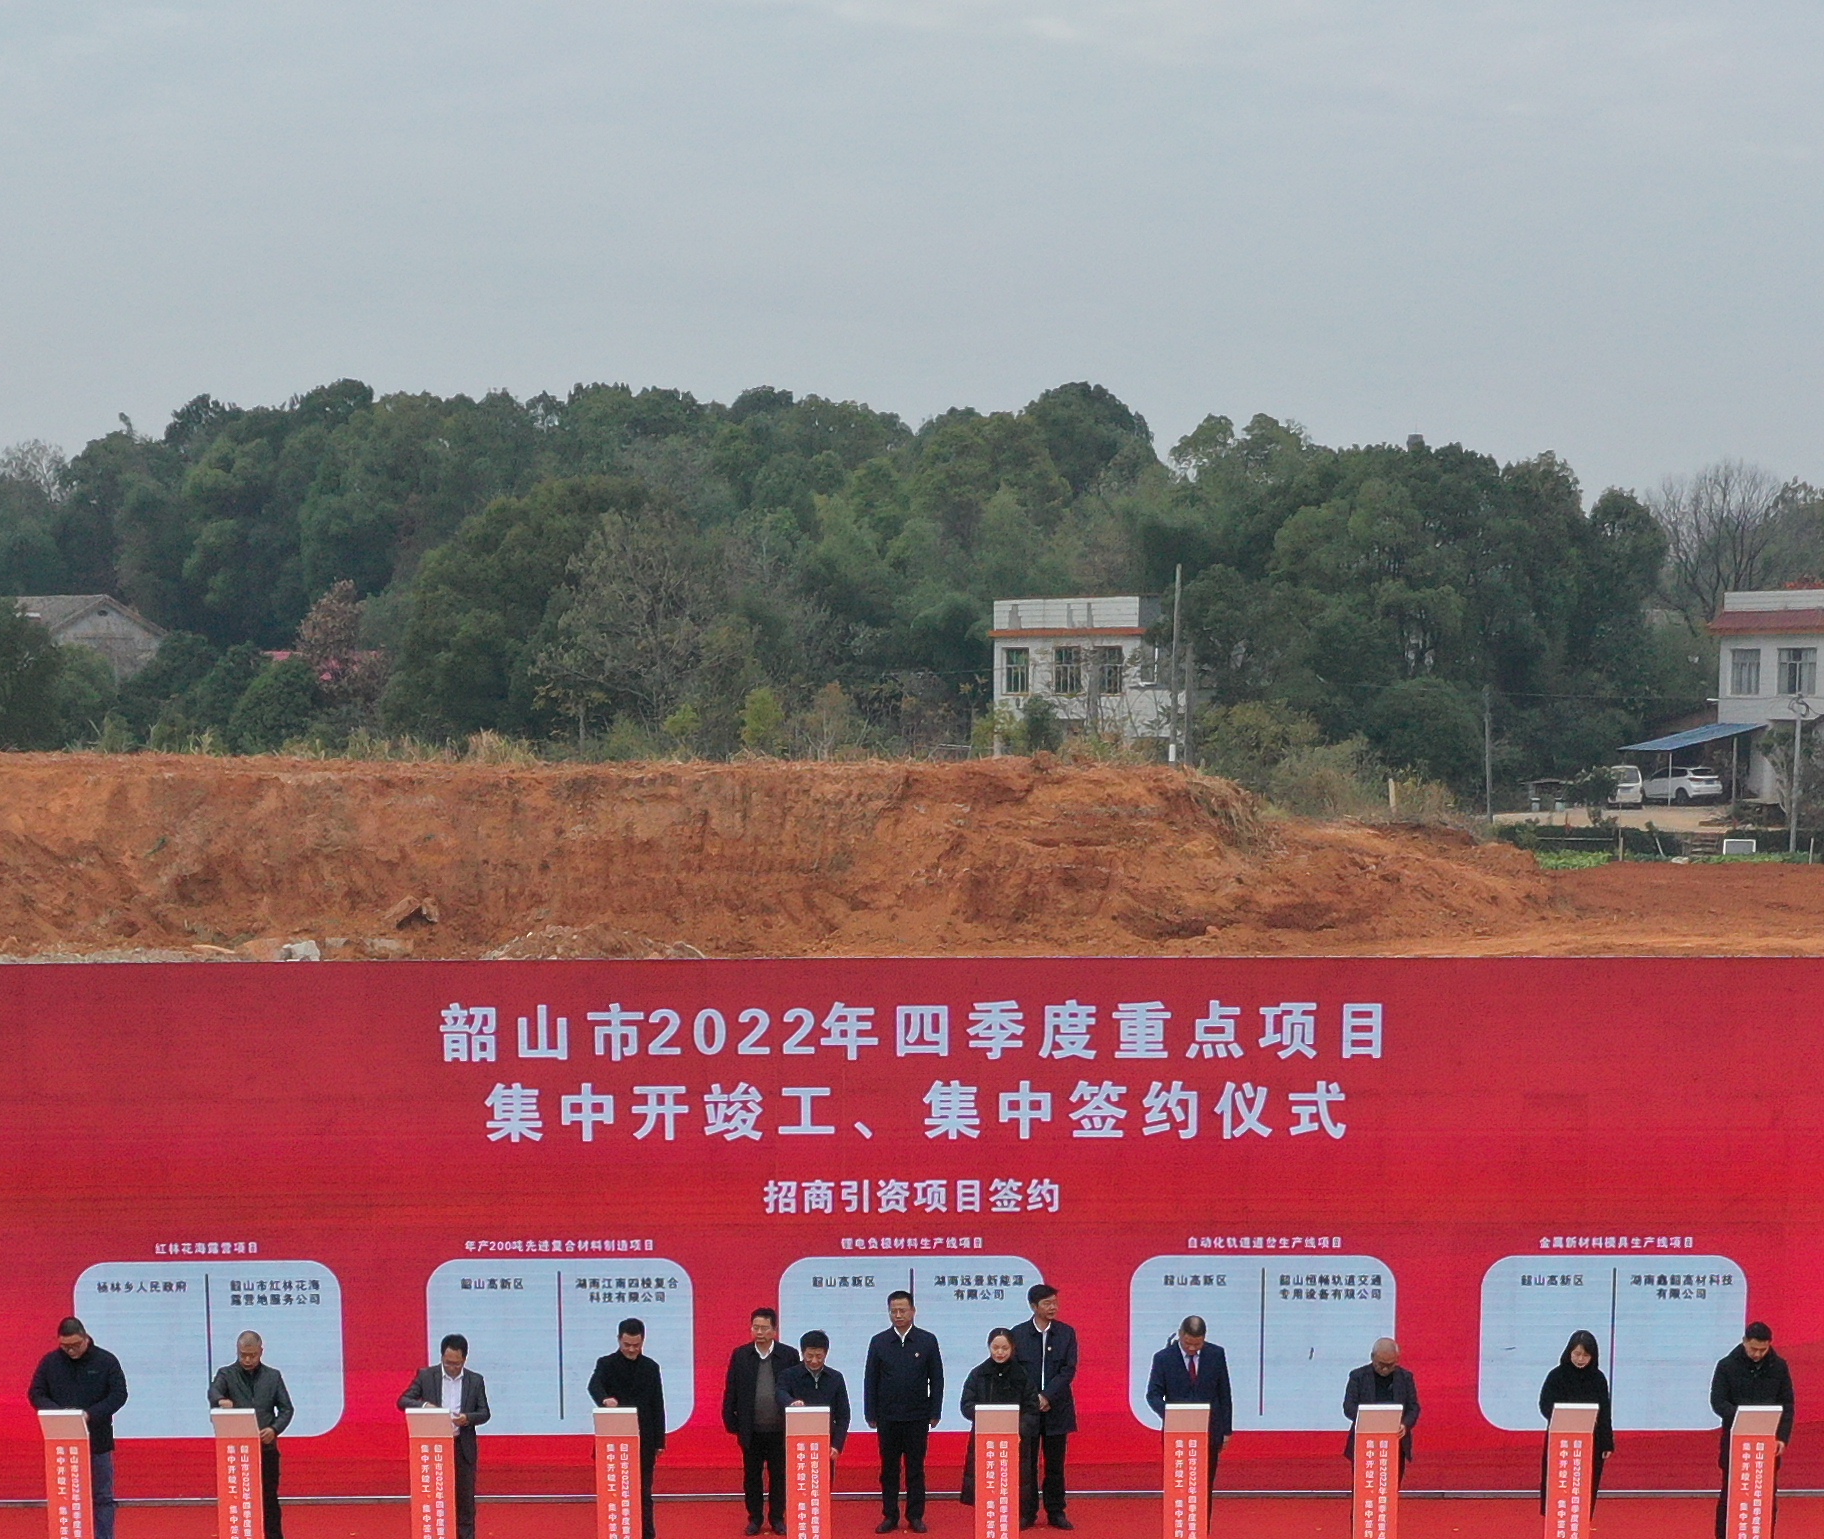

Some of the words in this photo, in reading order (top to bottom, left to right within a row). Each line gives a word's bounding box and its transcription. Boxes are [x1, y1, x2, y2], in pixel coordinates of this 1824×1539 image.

[439, 999, 1383, 1063] 韶山市2022年四季度重点项目
[484, 1079, 1347, 1143] 集中开竣工、集中签约仪式
[763, 1178, 1059, 1214] 招商引资项目签约
[155, 1241, 258, 1255] 红林花海露营项目
[465, 1239, 653, 1252] 年产200吨先进复合材料制造项目
[460, 1278, 524, 1290] 韶山高新区
[1164, 1274, 1226, 1286] 韶山高新区
[1521, 1274, 1583, 1286] 韶山高新区
[589, 1291, 666, 1303] 科技有限公司
[953, 1288, 1004, 1301] 有限公司
[1656, 1288, 1707, 1300] 有限公司
